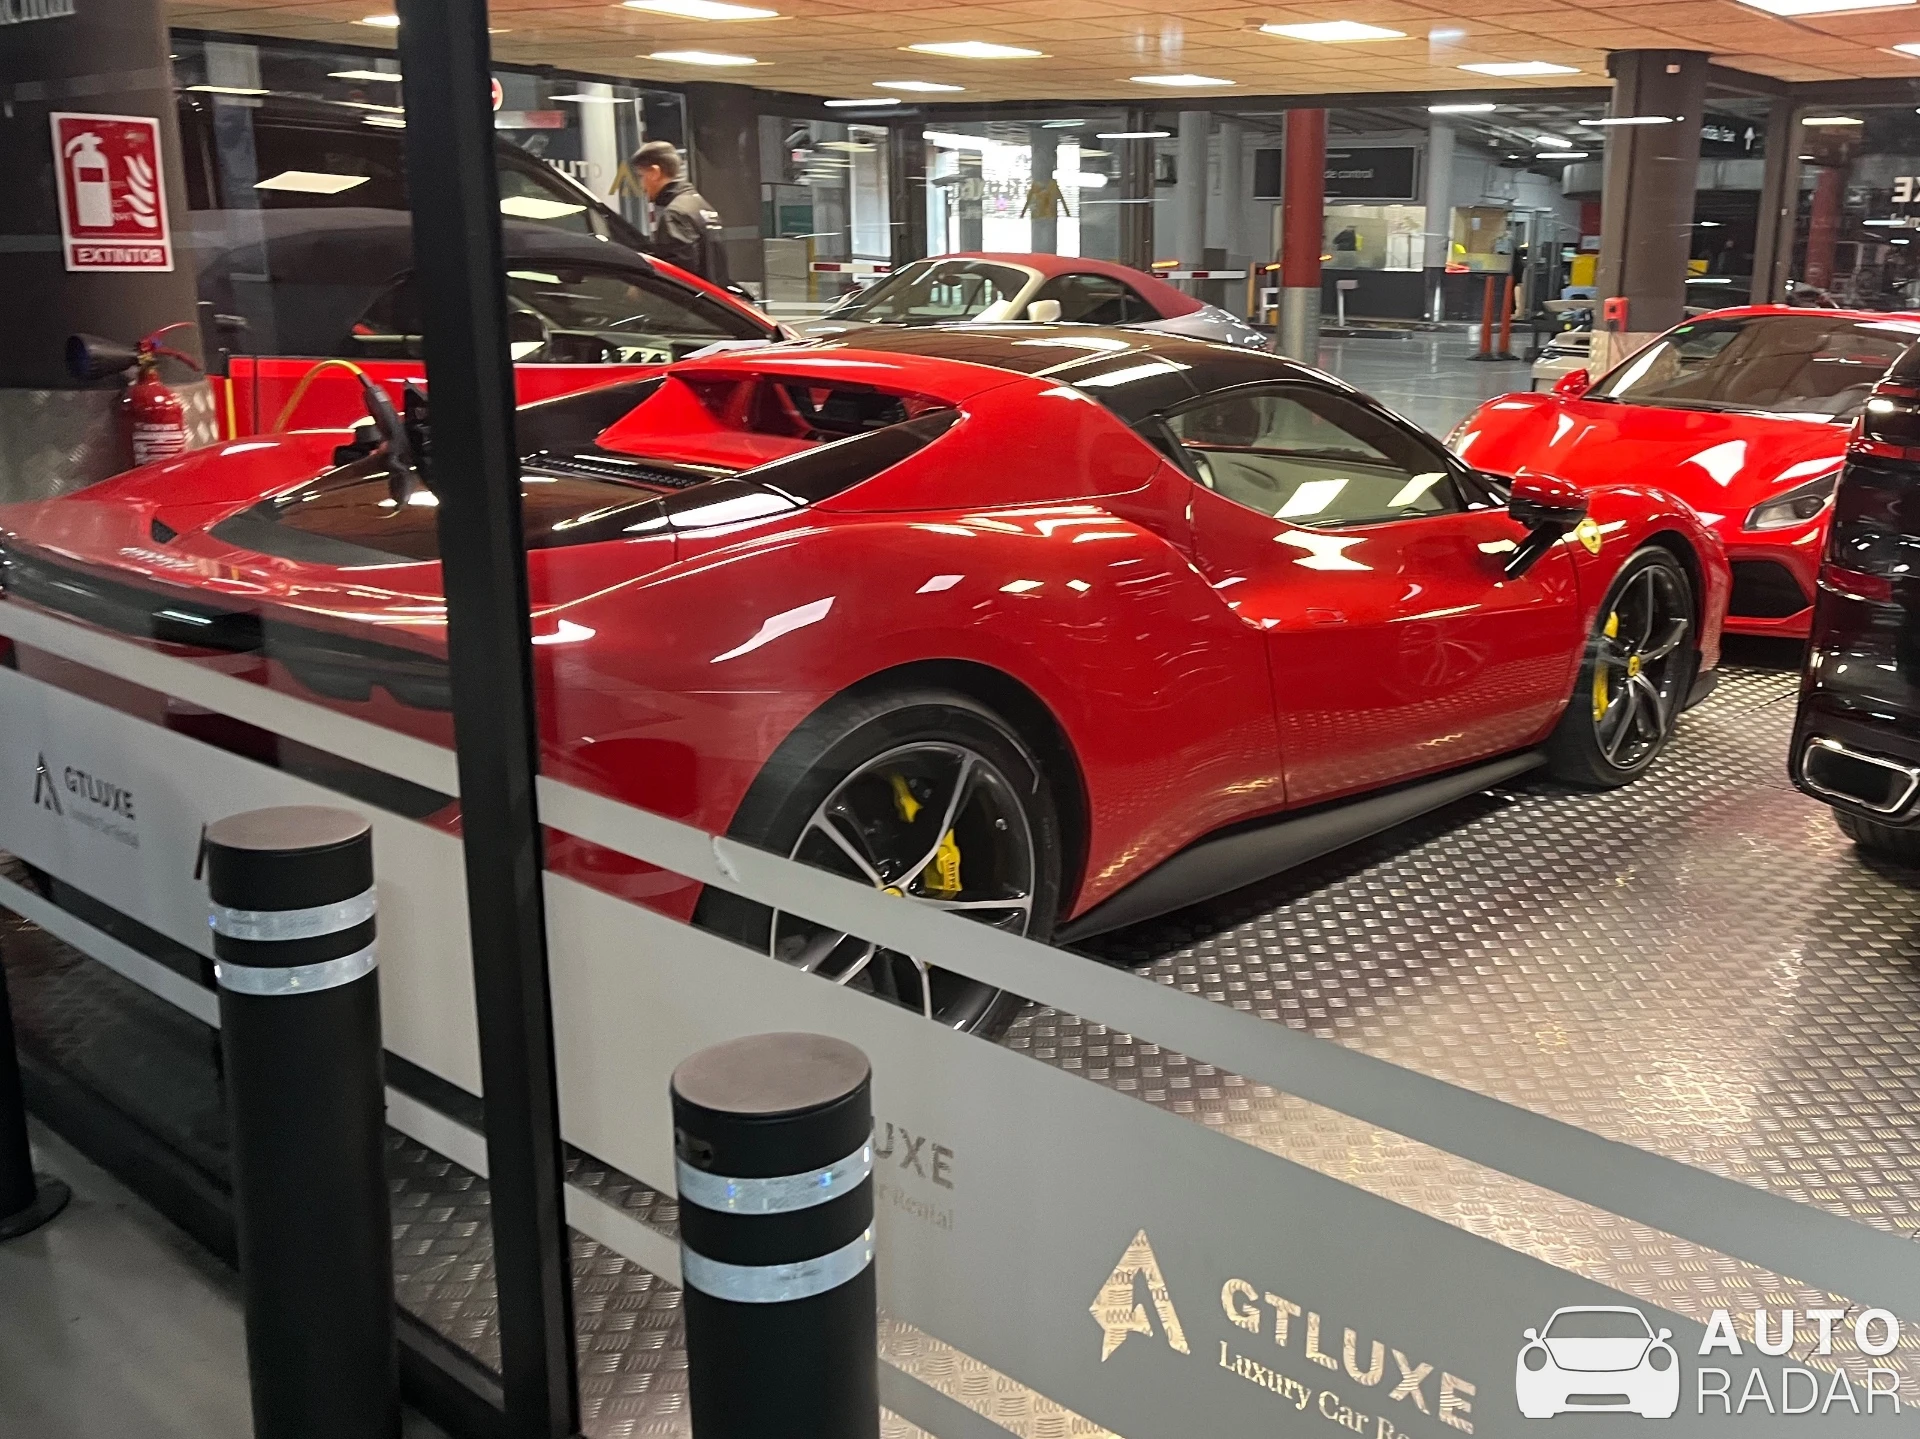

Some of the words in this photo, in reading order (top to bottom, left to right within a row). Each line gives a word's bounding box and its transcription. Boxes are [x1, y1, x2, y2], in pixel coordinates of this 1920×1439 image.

[77, 247, 164, 263] EXTINTOR
[64, 765, 136, 821] GTLUXE
[1219, 1340, 1312, 1410] Luxury
[1318, 1390, 1369, 1434] Car
[1221, 1278, 1477, 1435] GTLUXE
